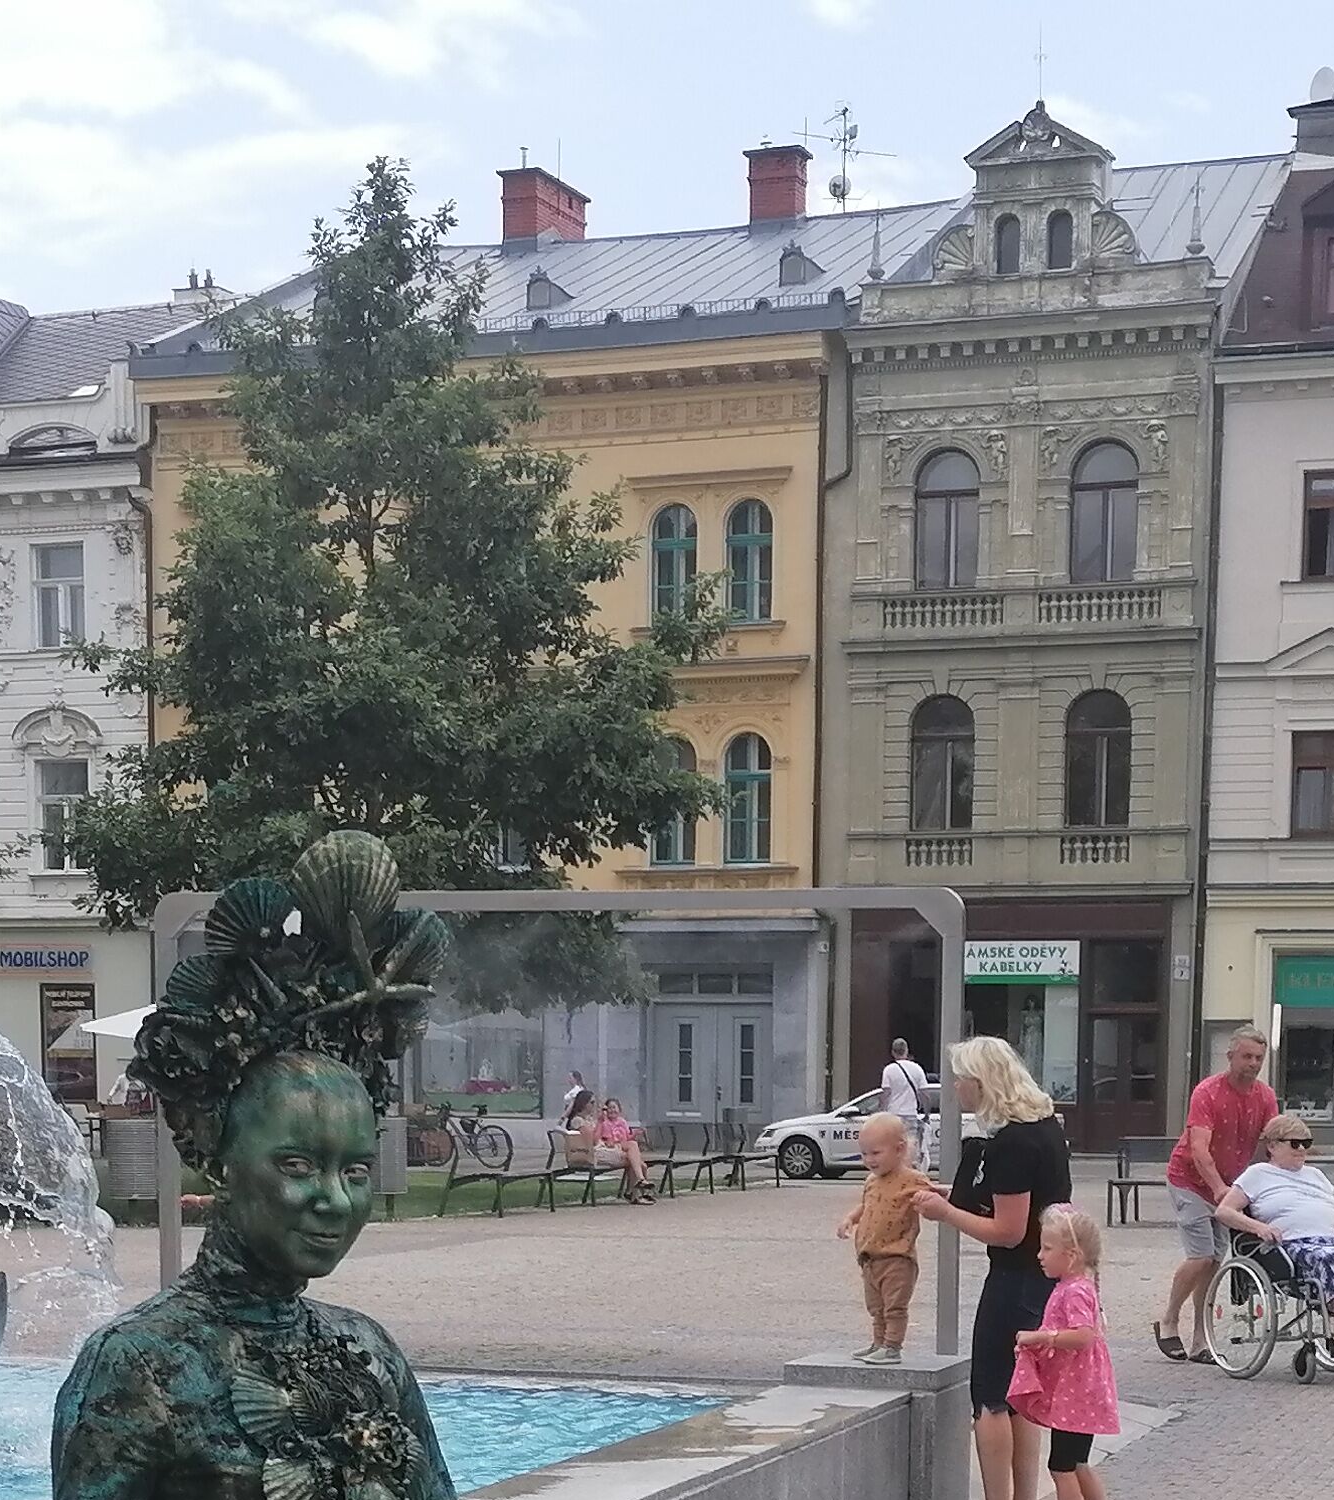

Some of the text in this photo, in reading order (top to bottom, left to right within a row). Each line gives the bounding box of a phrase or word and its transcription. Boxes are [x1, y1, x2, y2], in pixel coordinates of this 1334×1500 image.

[966, 943, 1068, 959] ÁMSKÉ ODĚVY
[0, 951, 90, 968] MOBILSHOP
[978, 961, 1044, 973] KABELKY
